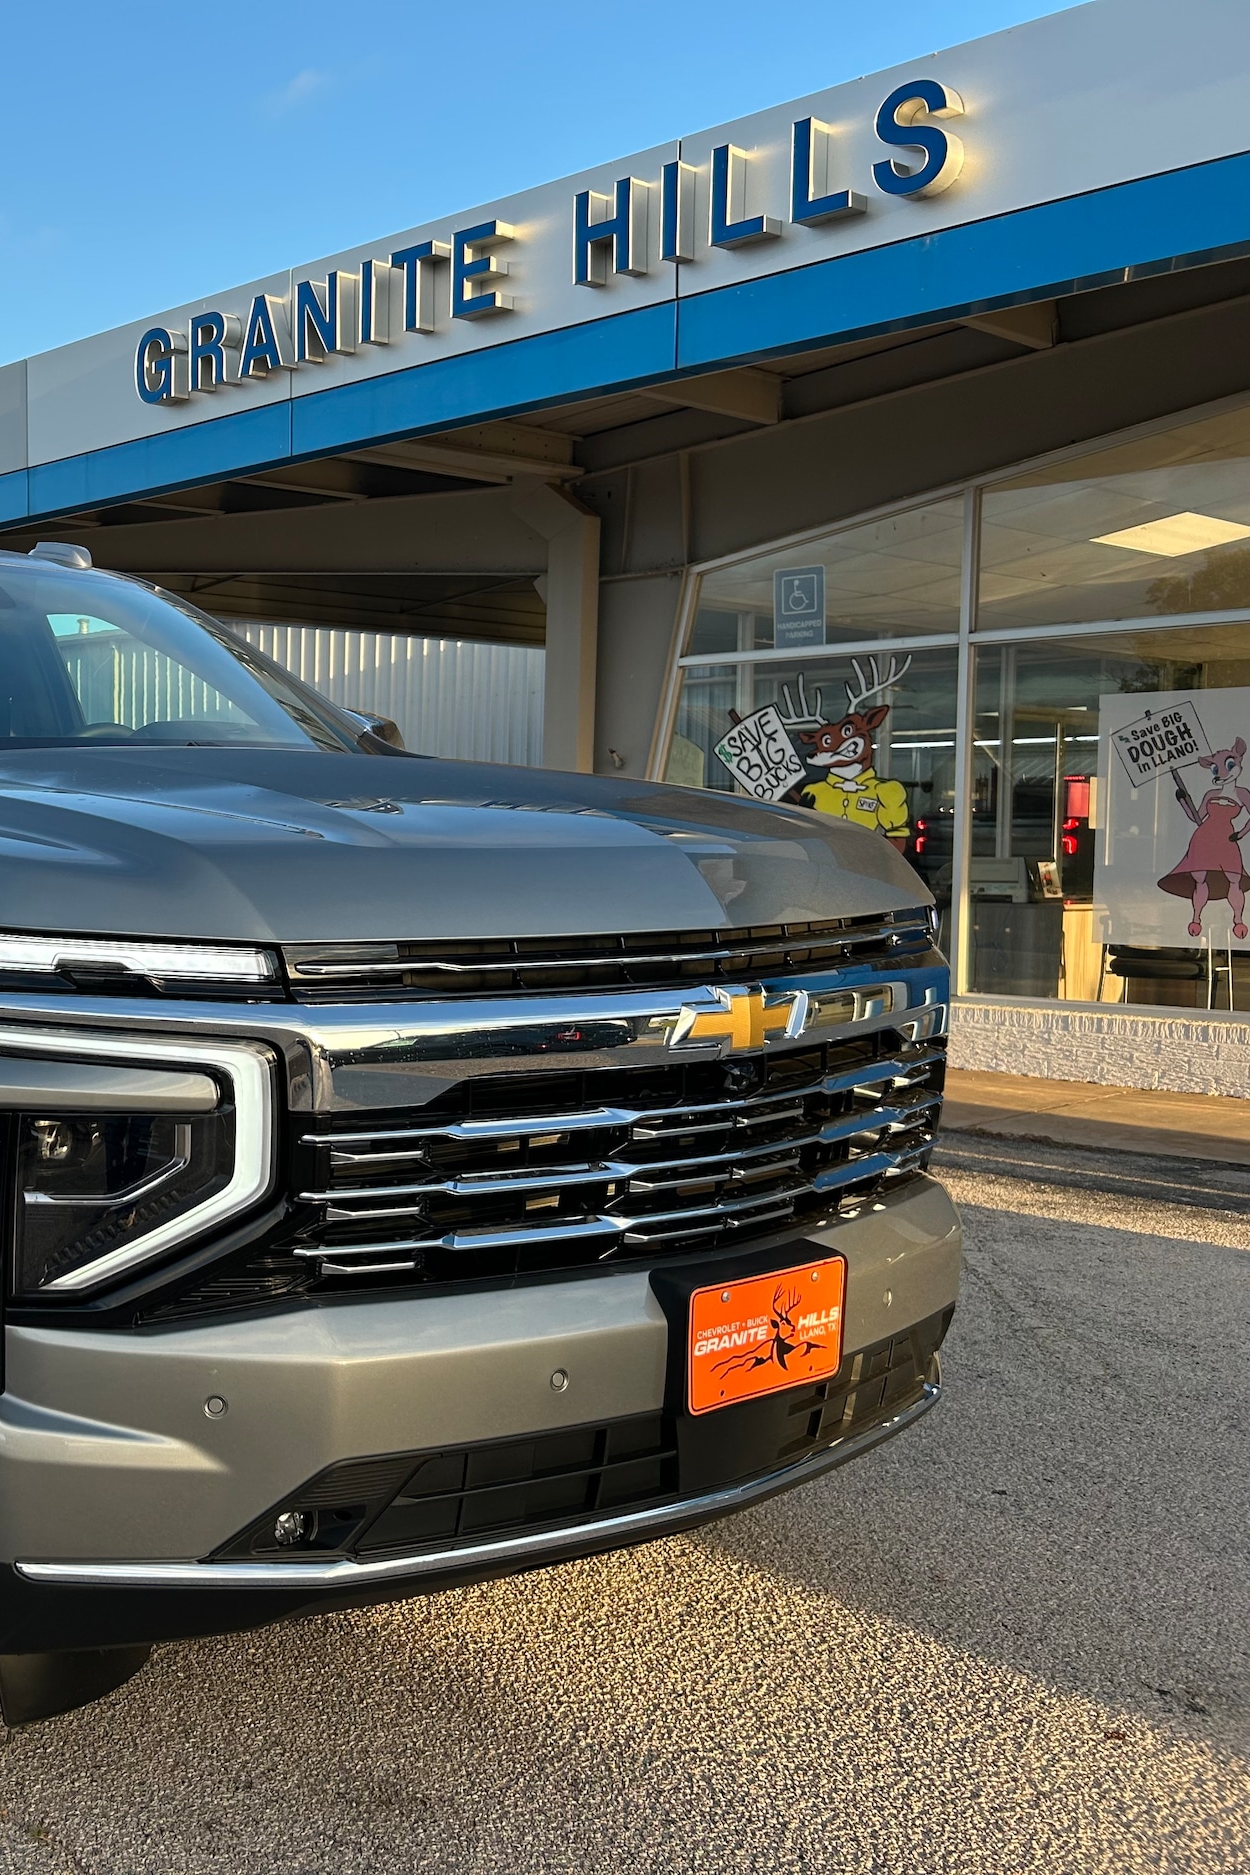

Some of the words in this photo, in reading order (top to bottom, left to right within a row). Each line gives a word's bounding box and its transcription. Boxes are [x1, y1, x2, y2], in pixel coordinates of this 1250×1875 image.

[135, 219, 513, 405] GRANITE
[573, 80, 964, 287] HILLS
[777, 619, 822, 631] HANDICAPPED
[785, 630, 814, 639] PARKING
[1161, 712, 1183, 728] BIG
[1127, 722, 1193, 763] DOUGH
[736, 736, 785, 782] BIG
[1137, 762, 1151, 774] in
[1151, 740, 1199, 768] LLANO!
[754, 754, 802, 800] BUCKS
[697, 1322, 740, 1340] CHEVROLET
[746, 1315, 769, 1328] BUICK
[797, 1306, 839, 1330] HILLS
[799, 1326, 826, 1340] LLANO,
[827, 1323, 836, 1333] TX
[694, 1325, 768, 1356] GRANITE
